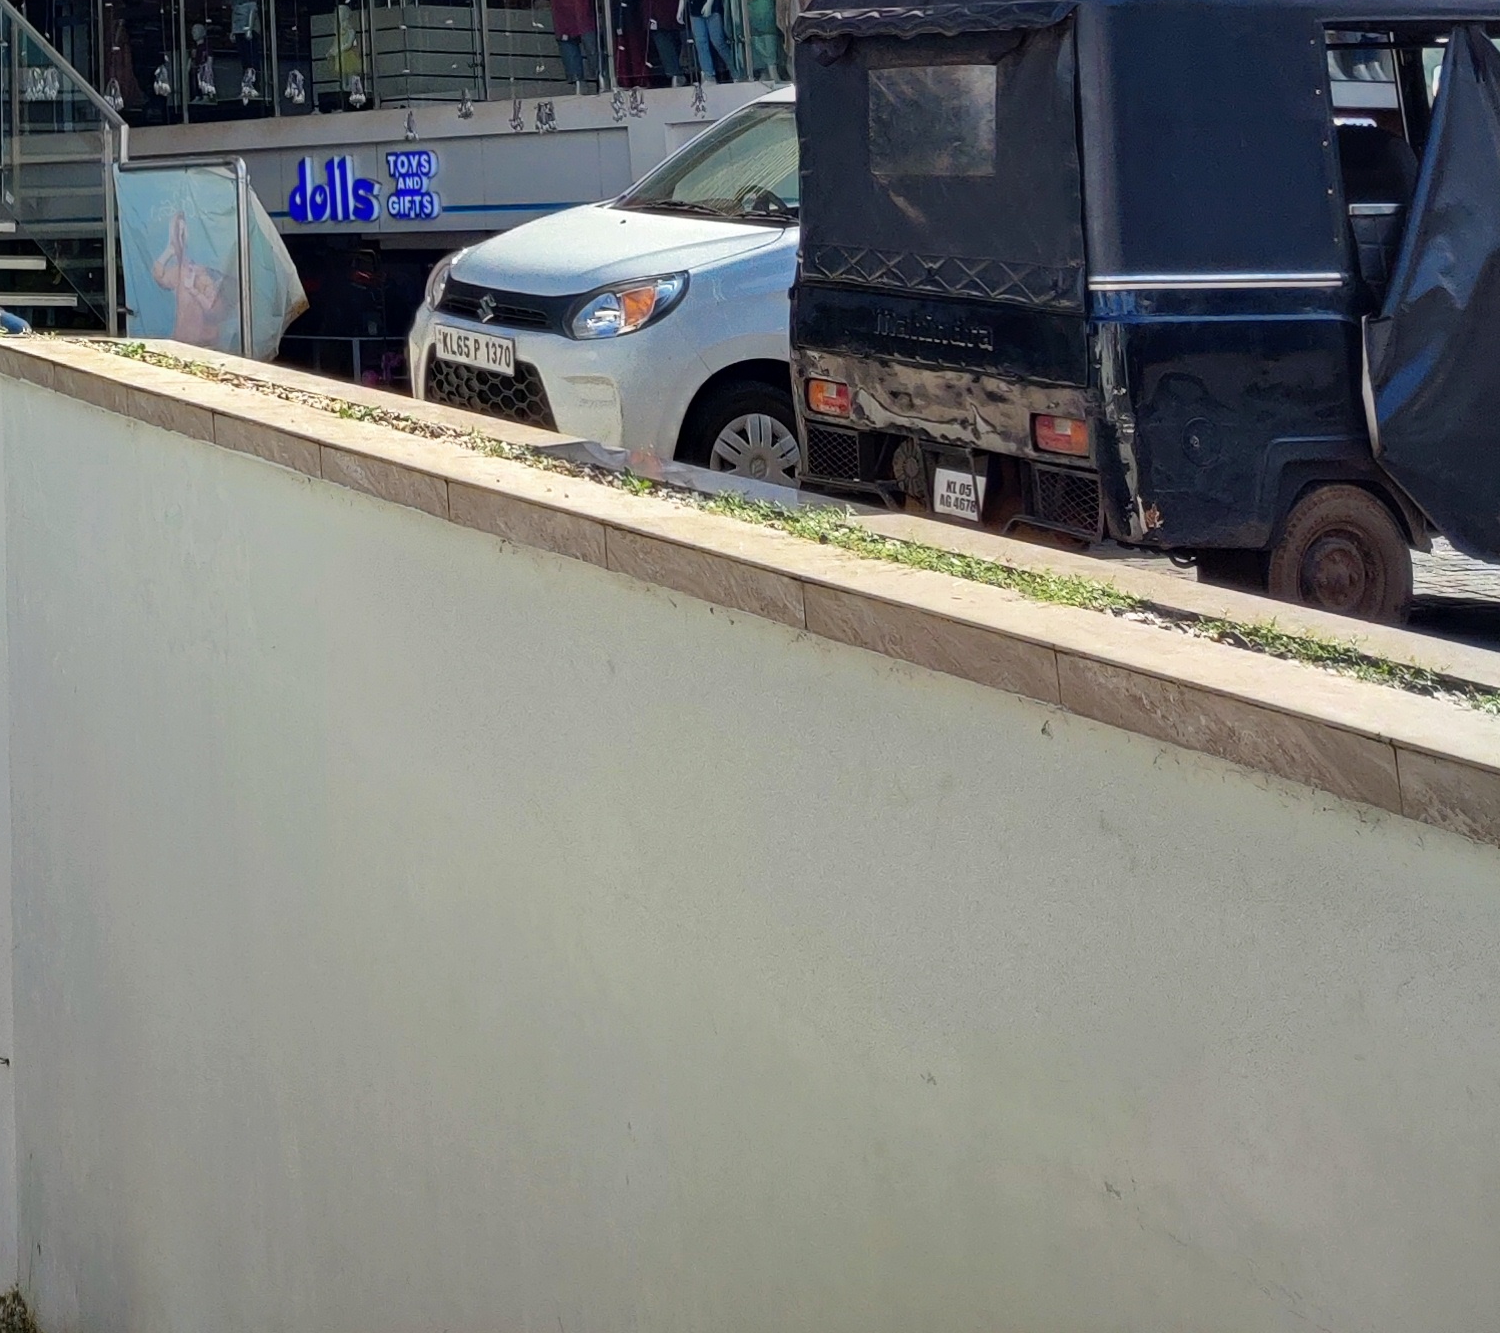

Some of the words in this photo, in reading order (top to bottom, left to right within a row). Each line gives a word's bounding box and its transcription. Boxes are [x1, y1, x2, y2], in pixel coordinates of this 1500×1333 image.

[387, 154, 431, 176] TOYS
[289, 155, 382, 223] dolls
[397, 175, 422, 191] AND
[388, 194, 433, 218] GIFTS
[442, 331, 470, 359] KL65
[473, 338, 480, 361] P
[485, 341, 511, 368] 1370
[946, 479, 957, 494] KL
[959, 483, 972, 497] 05
[940, 493, 952, 508] AG
